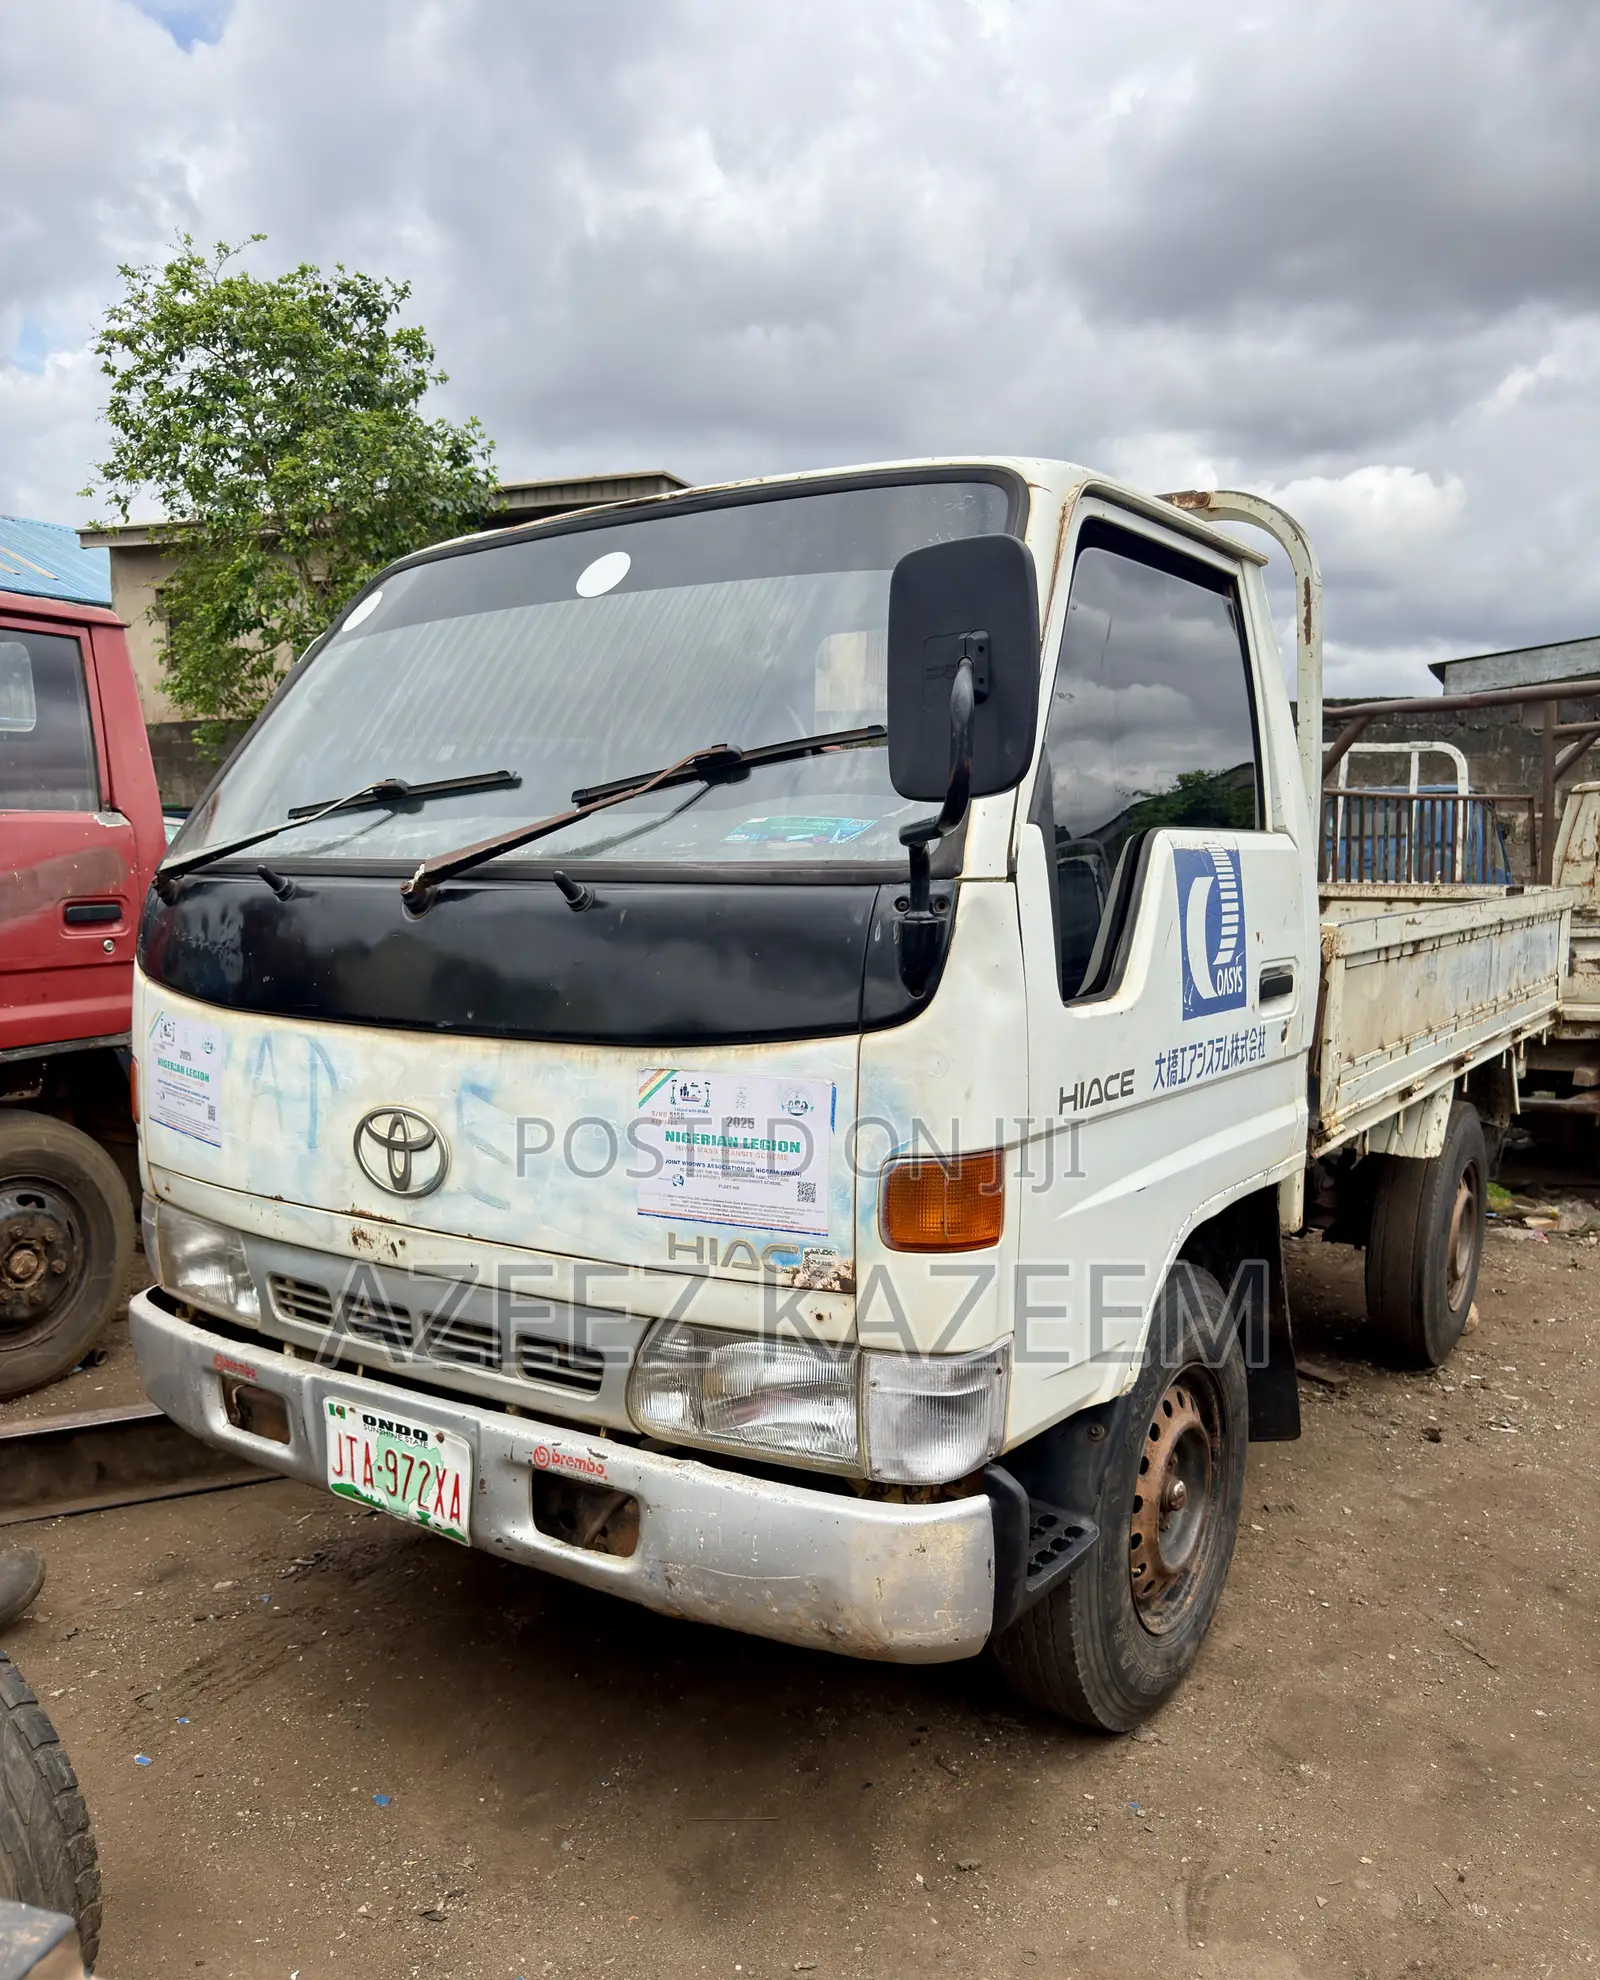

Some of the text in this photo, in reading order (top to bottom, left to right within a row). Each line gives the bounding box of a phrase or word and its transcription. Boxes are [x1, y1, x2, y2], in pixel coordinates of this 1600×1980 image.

[1217, 966, 1243, 997] OASYS
[1153, 1025, 1266, 1091] 大橋エアシステム株式会社
[1059, 1069, 1135, 1115] HIACE
[726, 1116, 755, 1129] 2025
[665, 1131, 801, 1153] NIGERIAN LEGION
[363, 1414, 429, 1441] ONDO
[363, 1424, 429, 1449] SUNSHINE STATE
[551, 1448, 605, 1475] brembo
